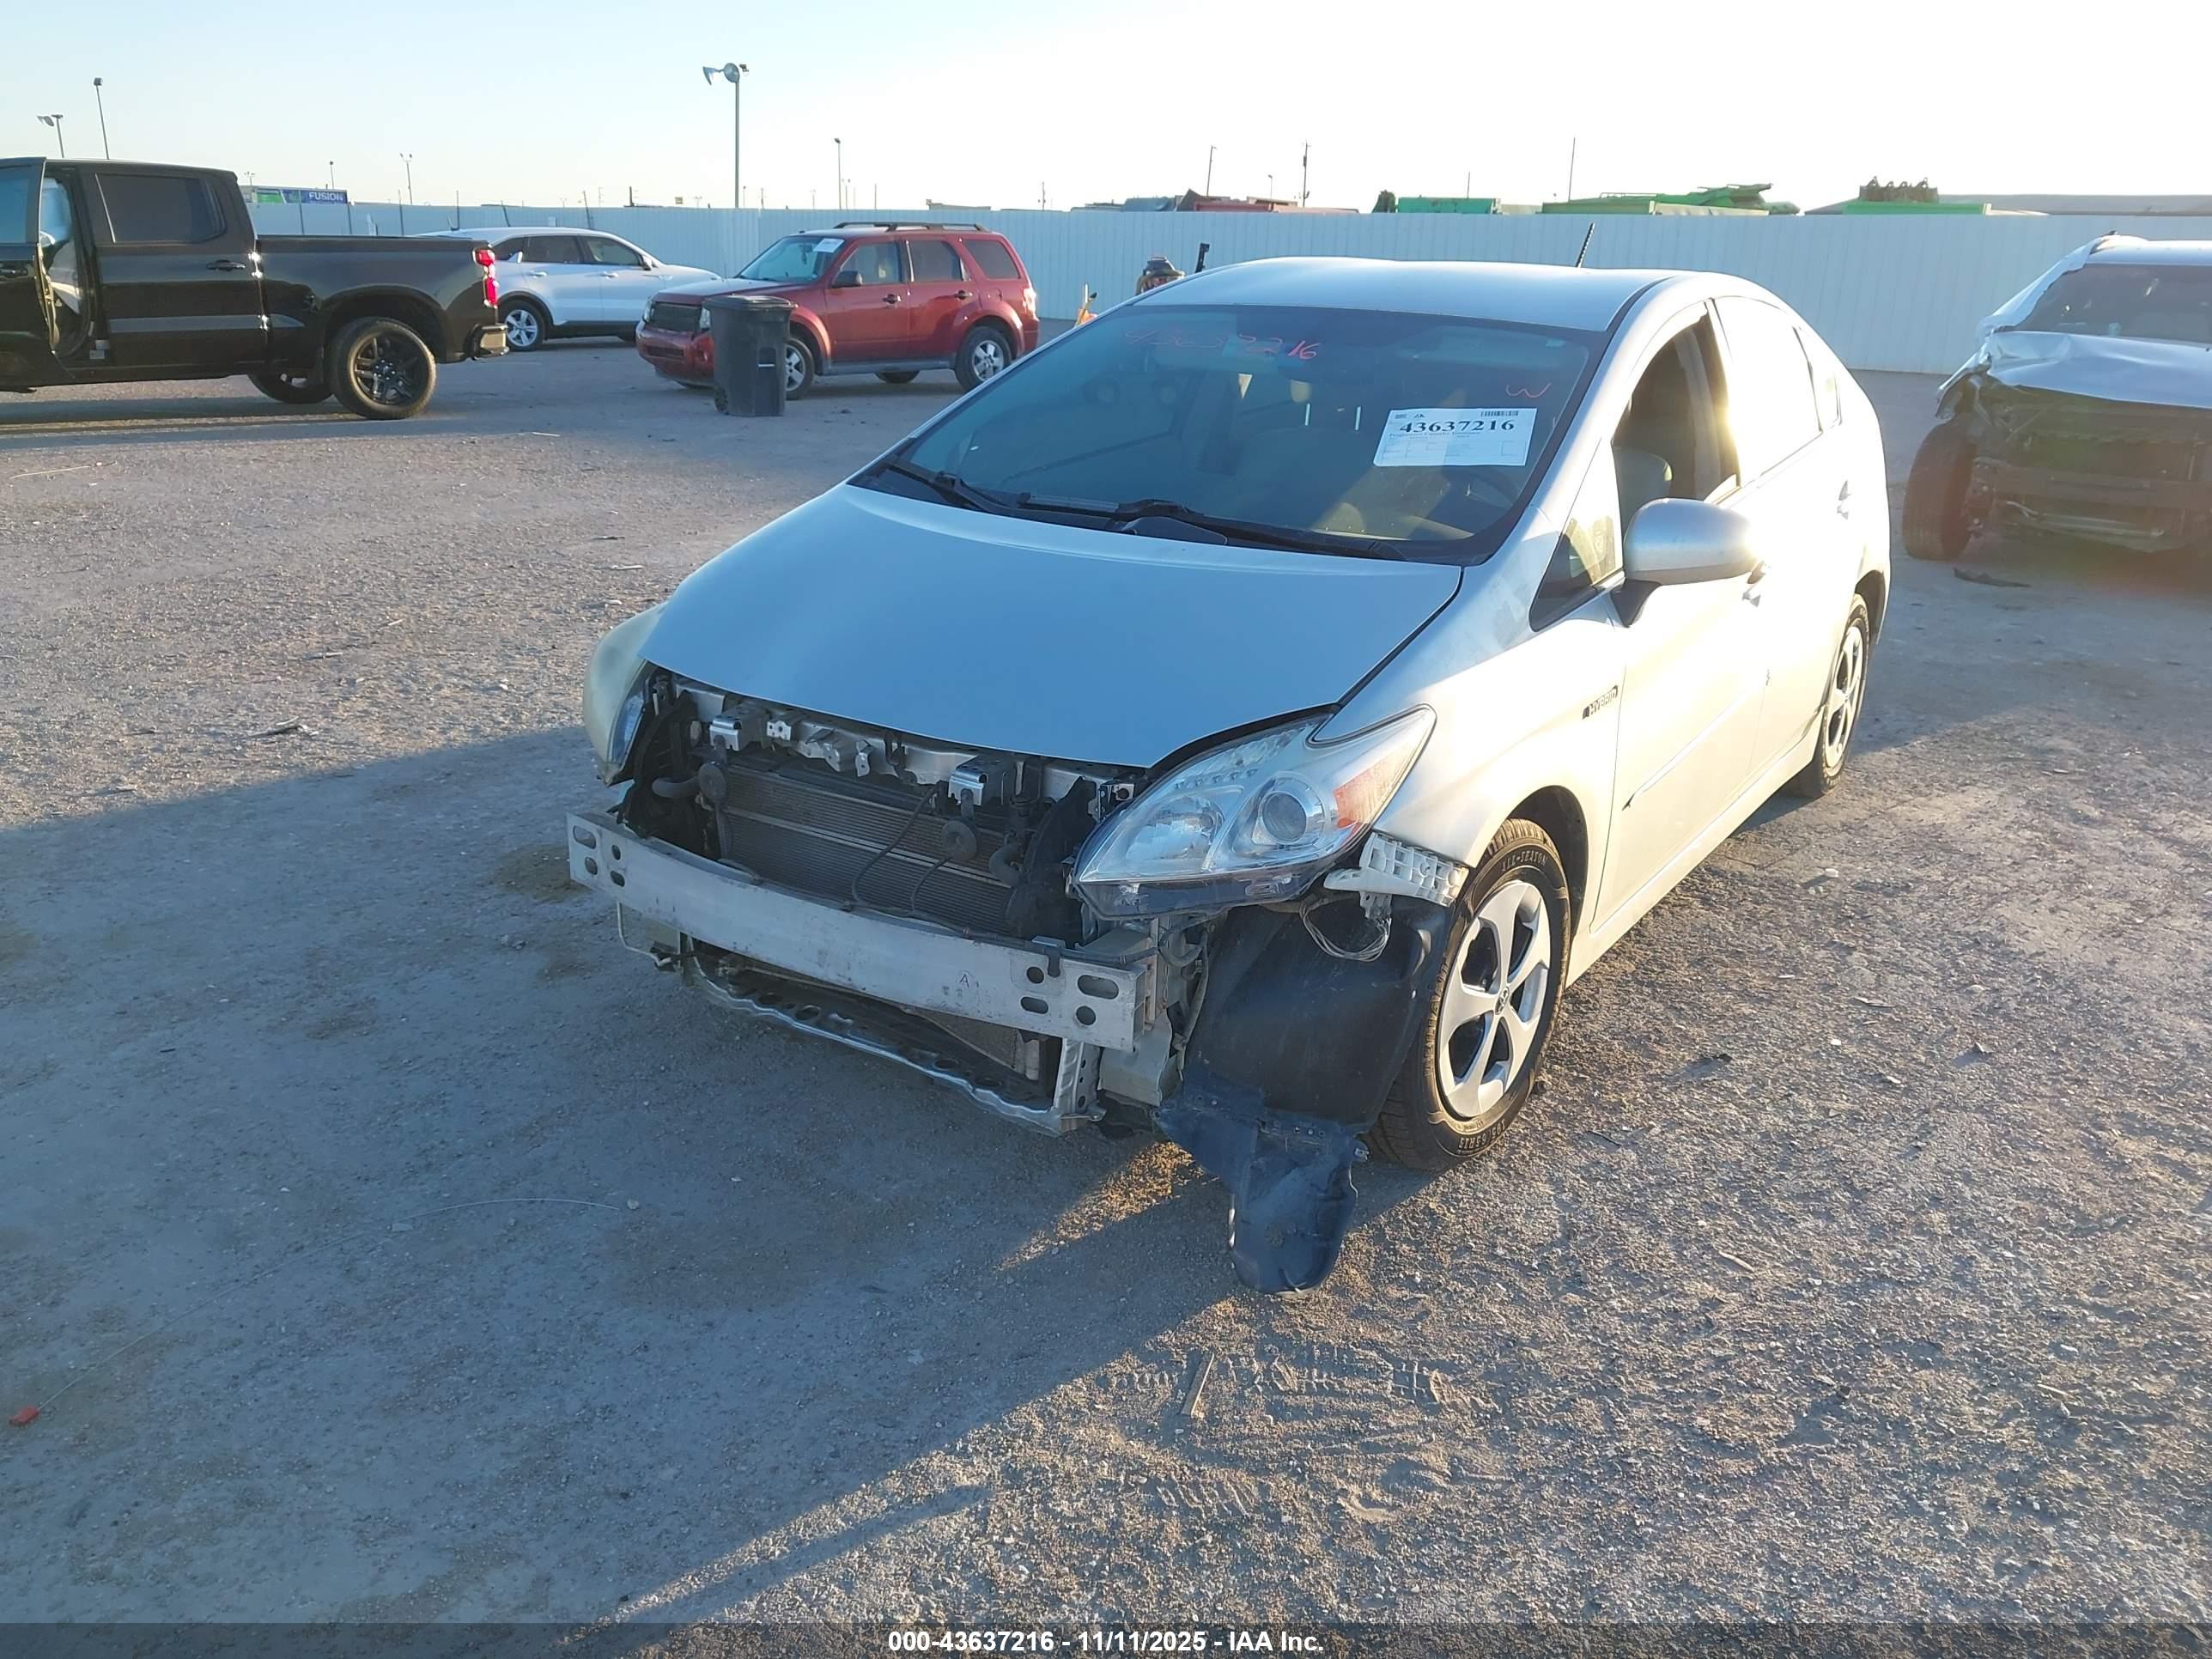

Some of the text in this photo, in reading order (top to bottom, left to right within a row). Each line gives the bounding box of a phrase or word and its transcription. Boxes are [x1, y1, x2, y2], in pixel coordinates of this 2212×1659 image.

[309, 191, 343, 201] FUSION
[1399, 419, 1516, 433] 43637216
[1502, 850, 1548, 872] ALL-SEASON
